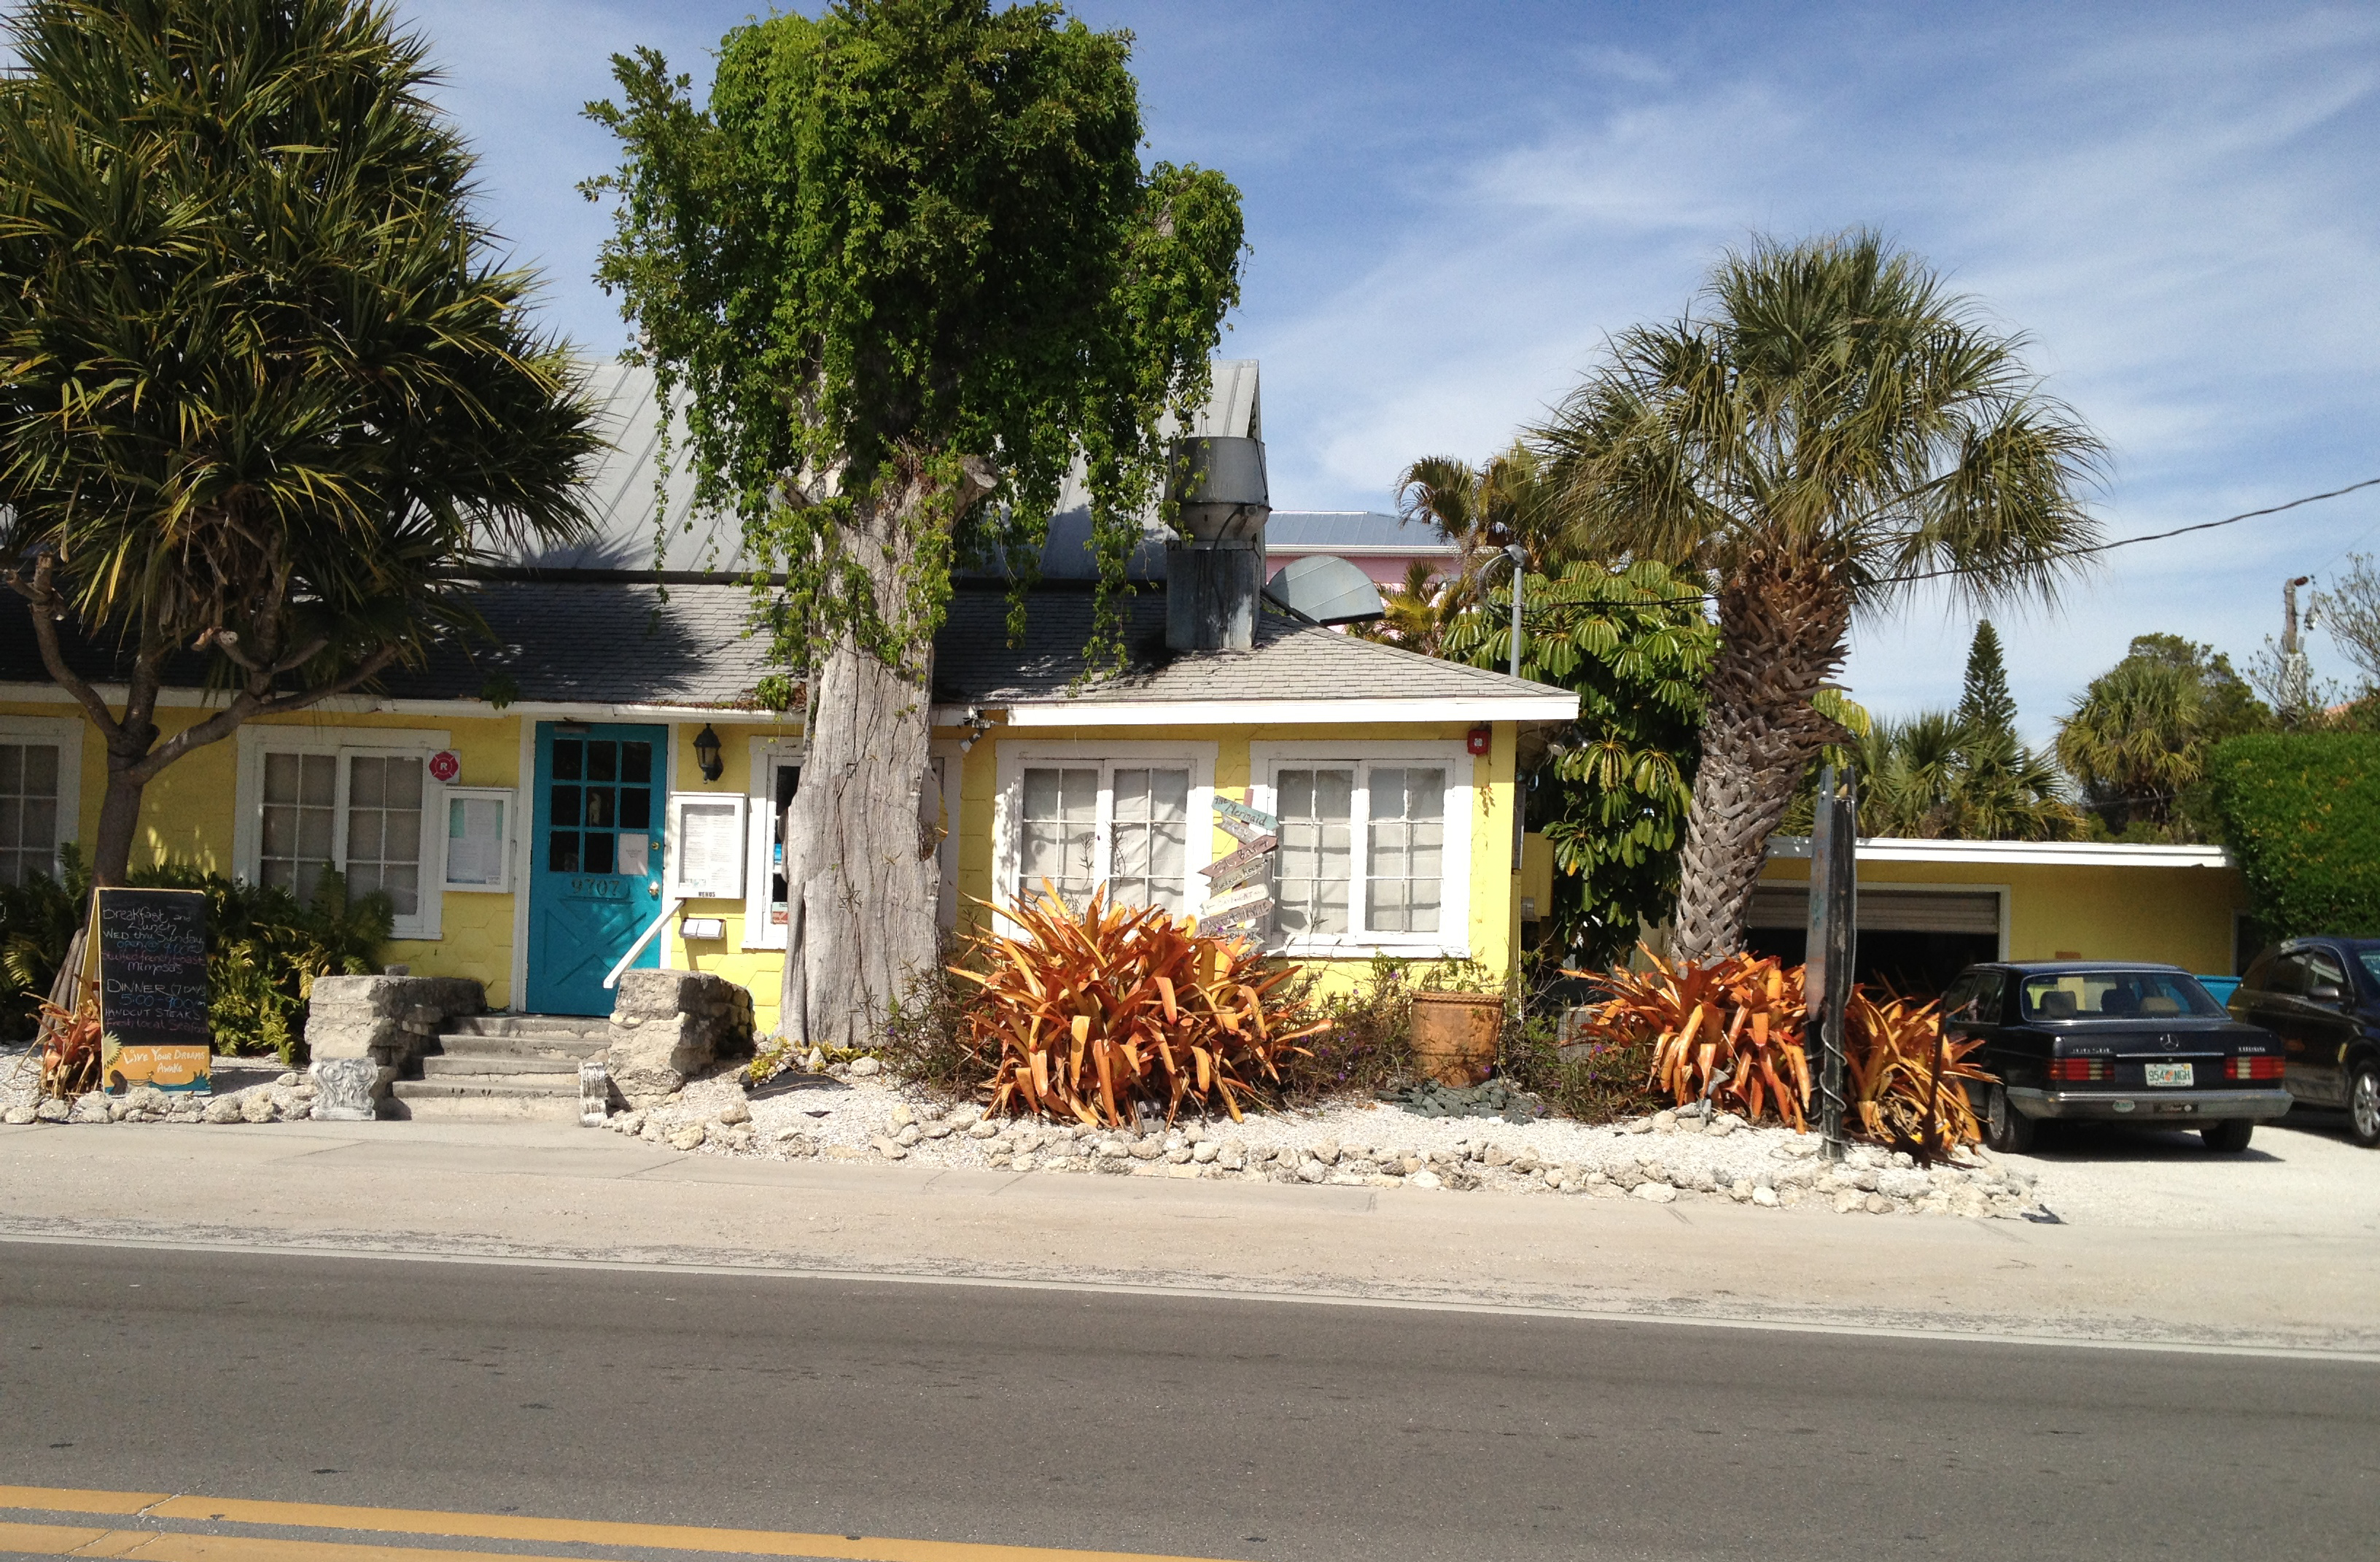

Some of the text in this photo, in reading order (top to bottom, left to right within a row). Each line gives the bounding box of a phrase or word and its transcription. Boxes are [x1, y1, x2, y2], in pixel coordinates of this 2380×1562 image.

[440, 762, 448, 771] R
[1226, 804, 1267, 826] Mermaid
[572, 878, 619, 896] 9707
[103, 906, 168, 925] Breakfast
[128, 922, 176, 936] Lunch
[157, 929, 204, 951] Sunday
[107, 979, 175, 997] DINNER
[155, 1008, 201, 1020] STEAKS
